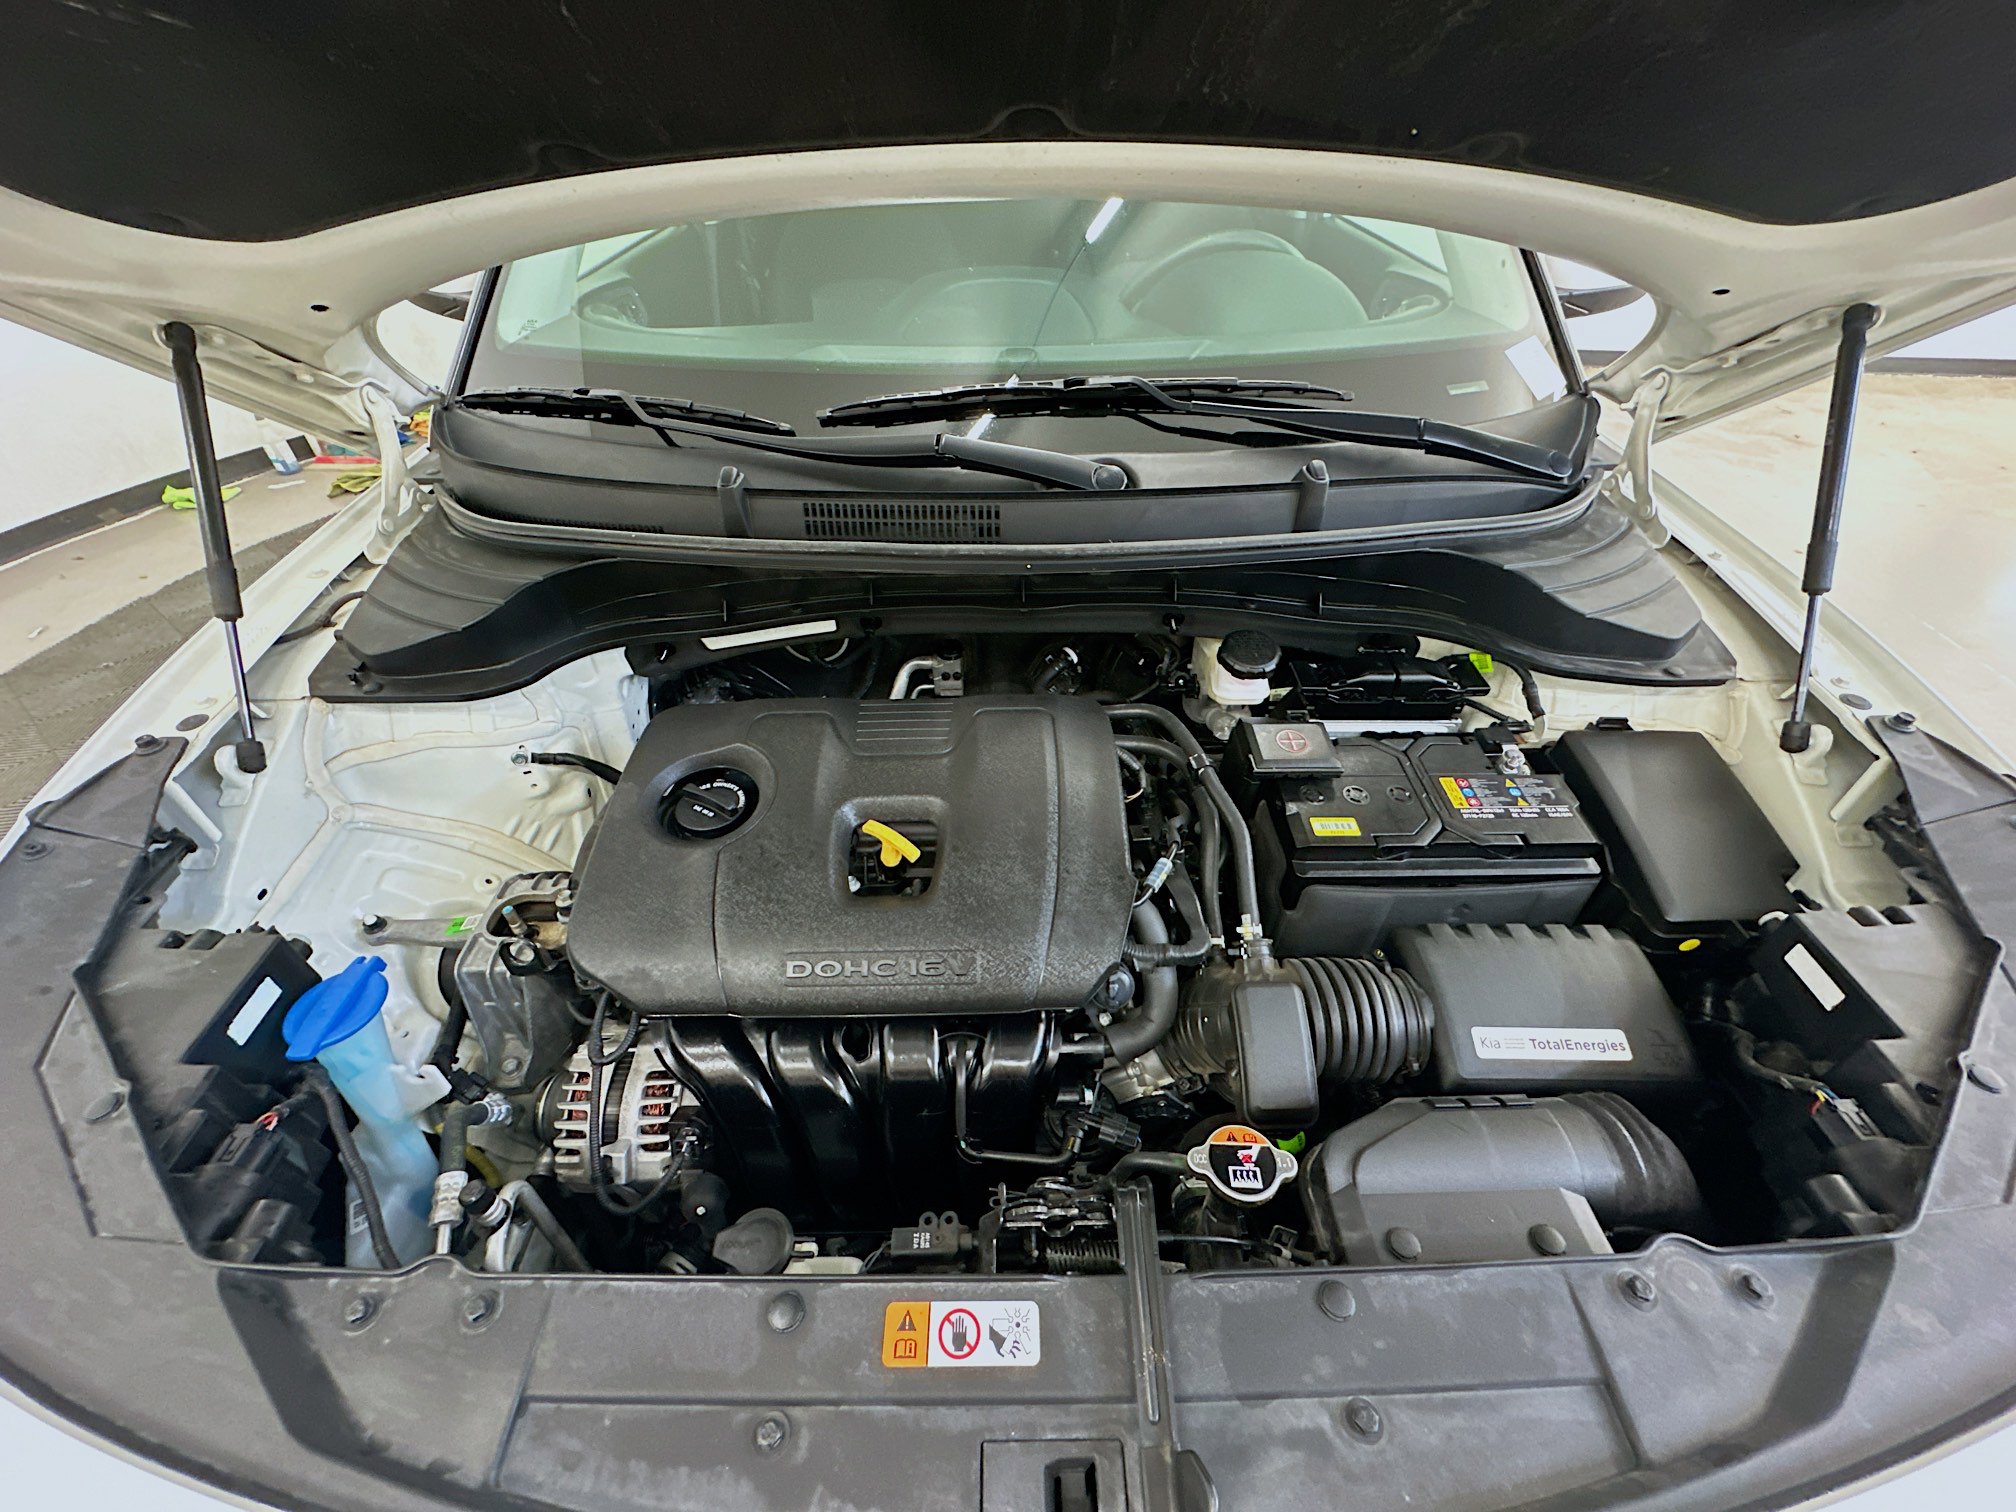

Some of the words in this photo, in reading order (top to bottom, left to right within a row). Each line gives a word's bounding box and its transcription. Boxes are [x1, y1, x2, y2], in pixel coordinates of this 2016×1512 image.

[785, 959, 898, 978] DOHC
[908, 958, 975, 977] 16V
[1479, 1037, 1502, 1049] Kia
[1528, 1038, 1626, 1053] TotalEnergies
